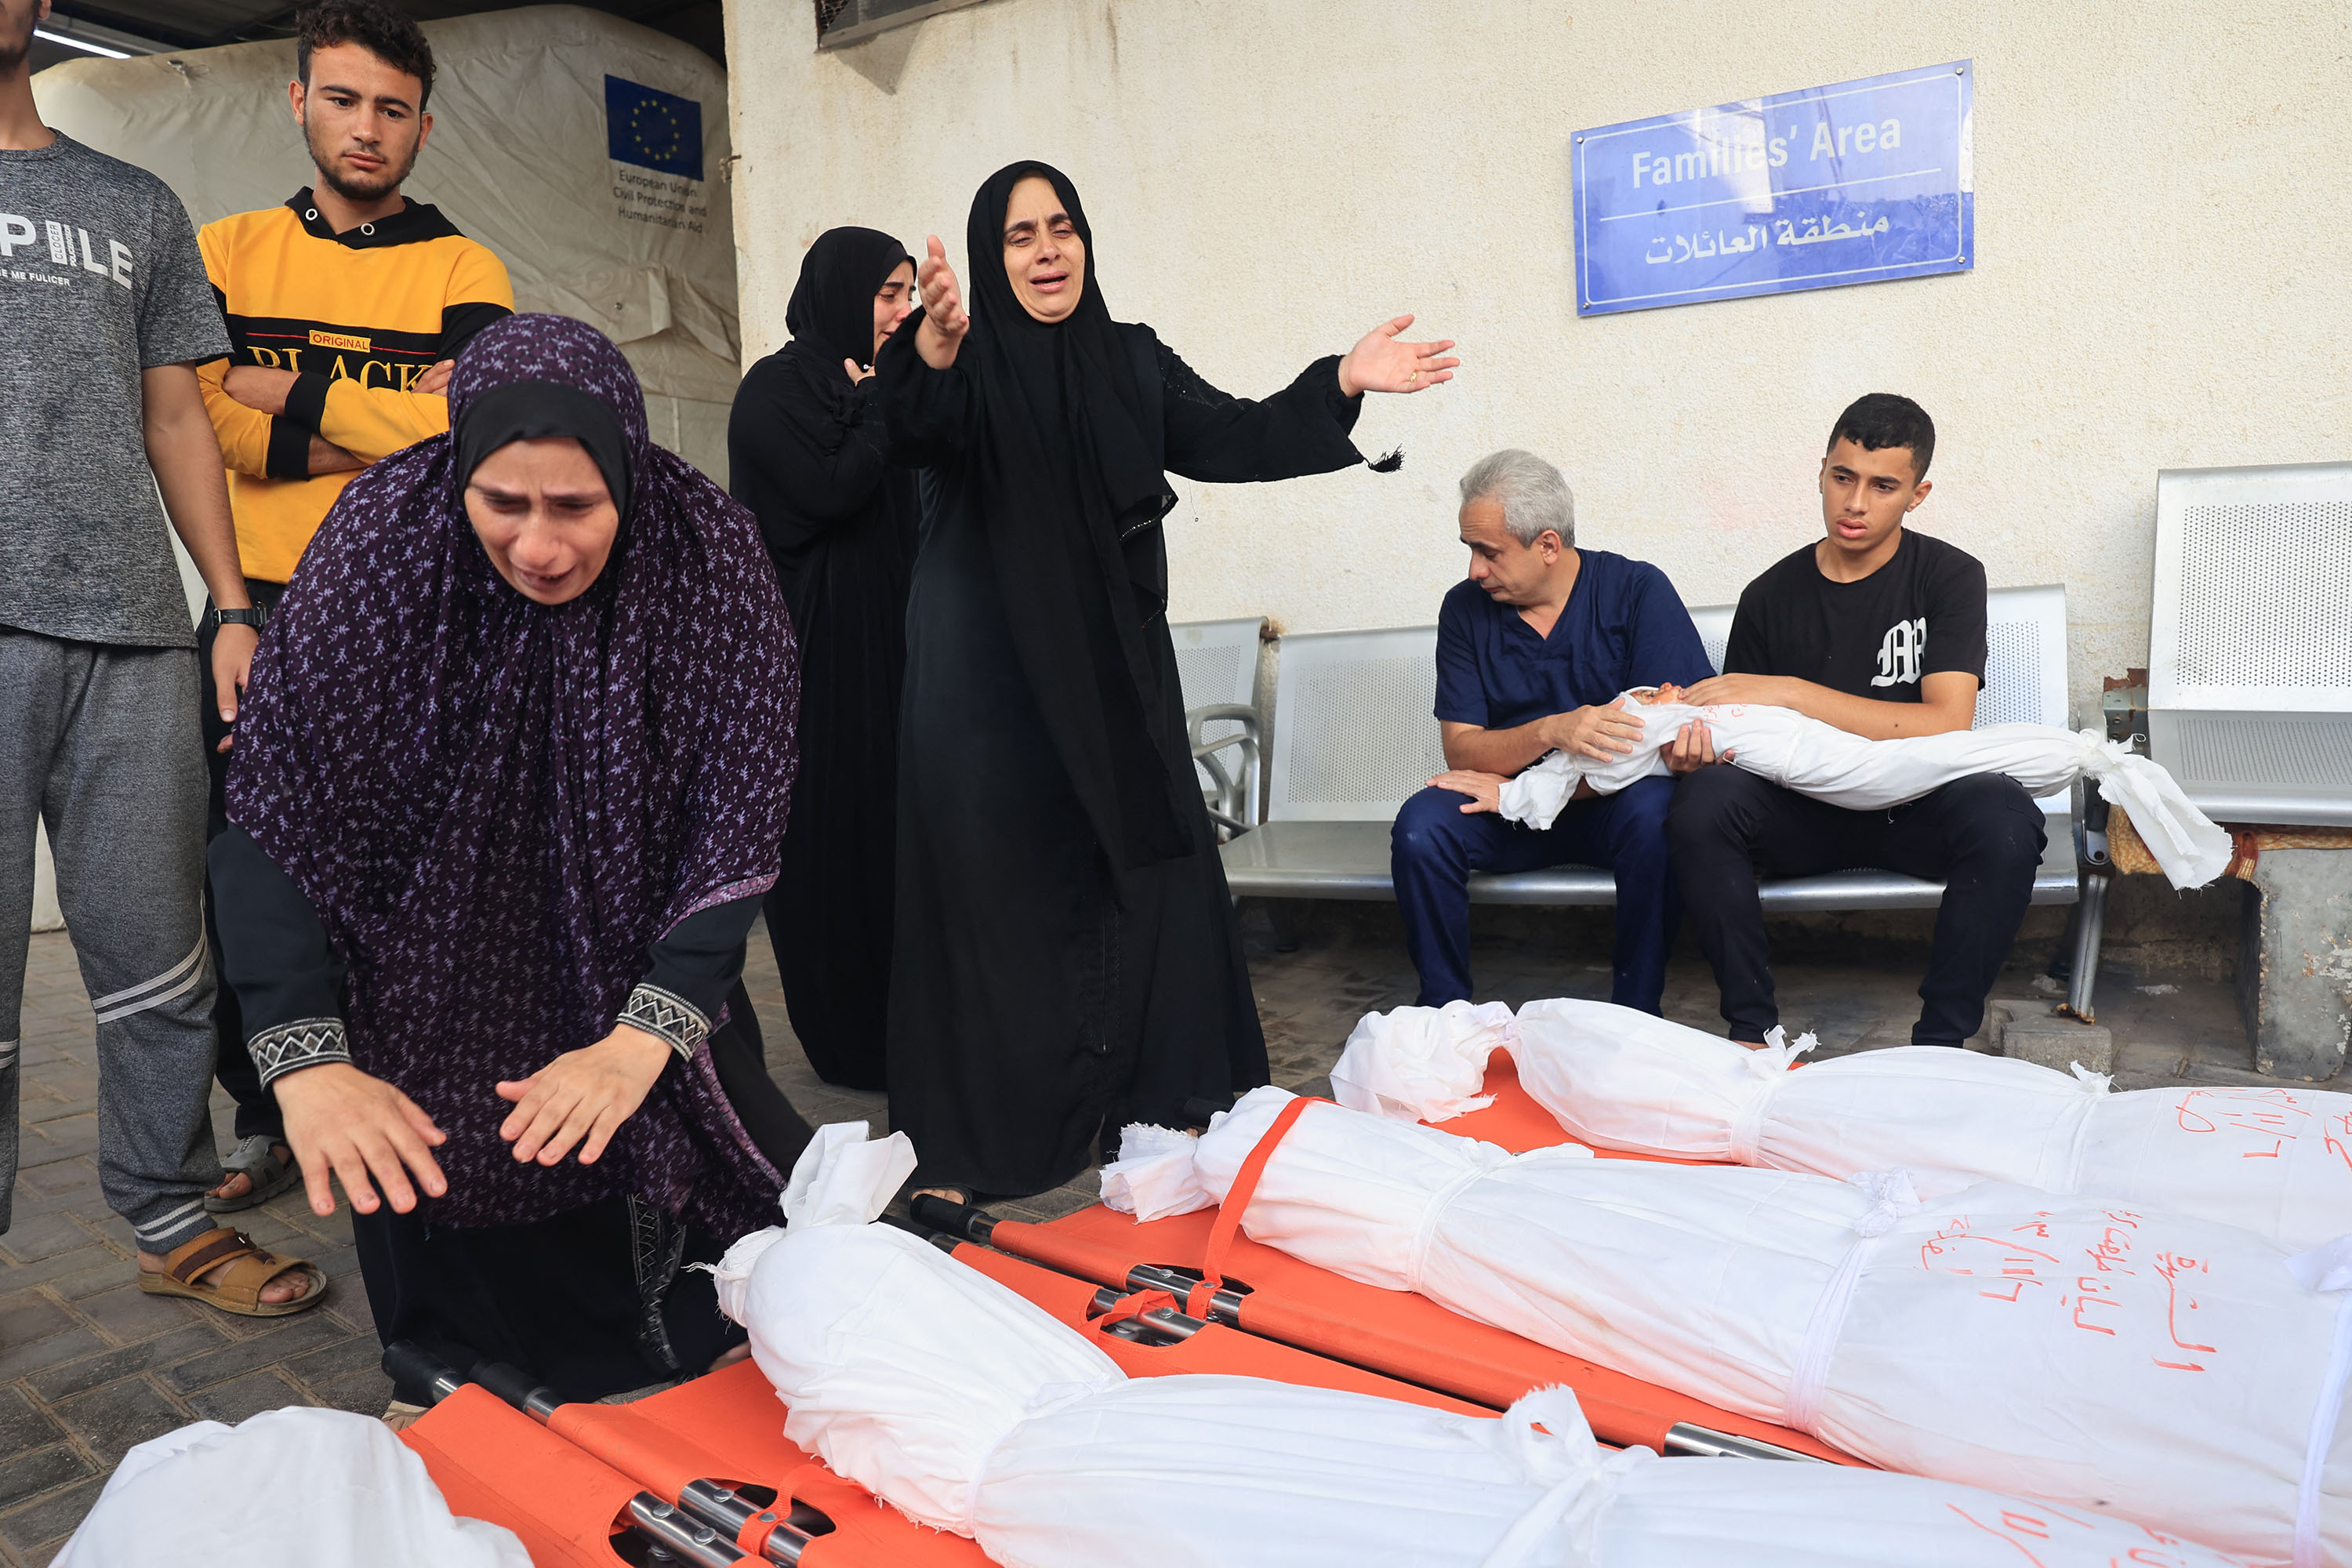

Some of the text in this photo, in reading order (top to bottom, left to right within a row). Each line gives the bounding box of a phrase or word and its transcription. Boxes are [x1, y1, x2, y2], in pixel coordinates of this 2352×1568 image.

[1809, 118, 1902, 162] Area
[619, 169, 697, 197] European Union
[613, 186, 706, 217] Civil Protection and
[618, 205, 703, 234] Humanitarian Aid
[1645, 211, 1889, 265] منطقة العائلات
[314, 333, 369, 351] ORIGINAL
